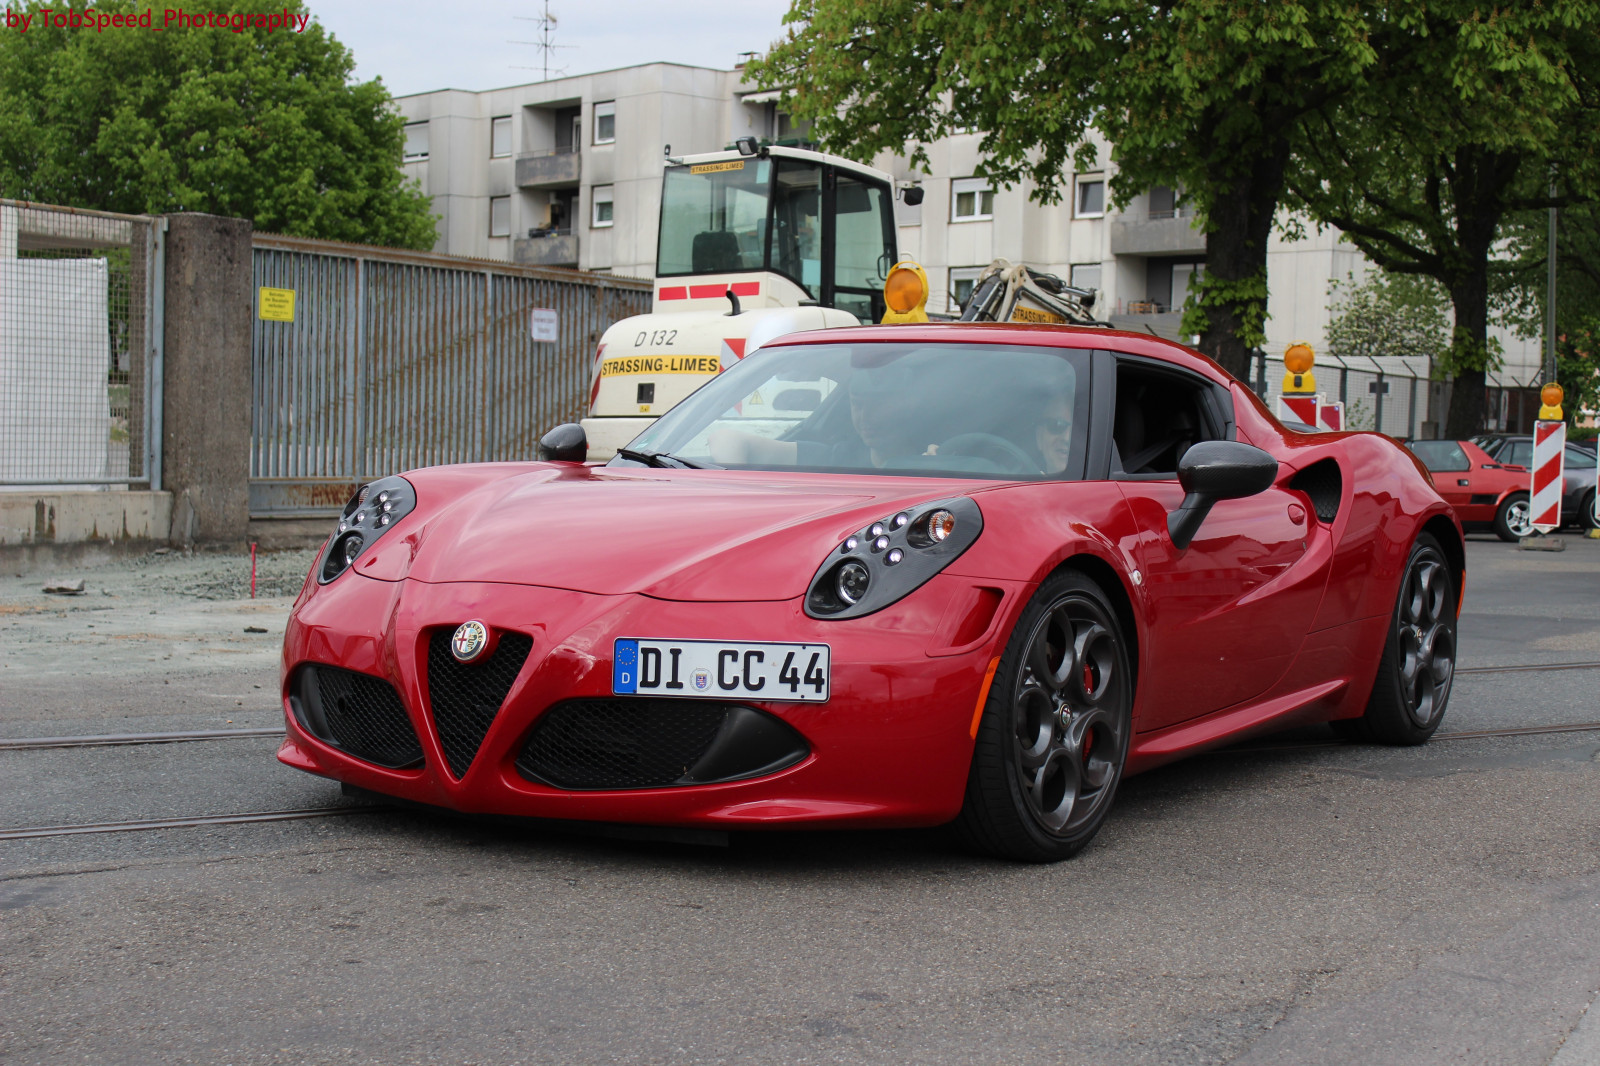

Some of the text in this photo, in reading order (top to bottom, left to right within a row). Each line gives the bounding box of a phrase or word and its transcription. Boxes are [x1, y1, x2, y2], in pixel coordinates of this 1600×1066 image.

[692, 162, 744, 174] STRASSING-LIMES
[635, 330, 678, 347] D 132
[602, 358, 718, 375] STRASSING-LIMES
[621, 672, 631, 684] D
[639, 647, 825, 693] DI CC 44
